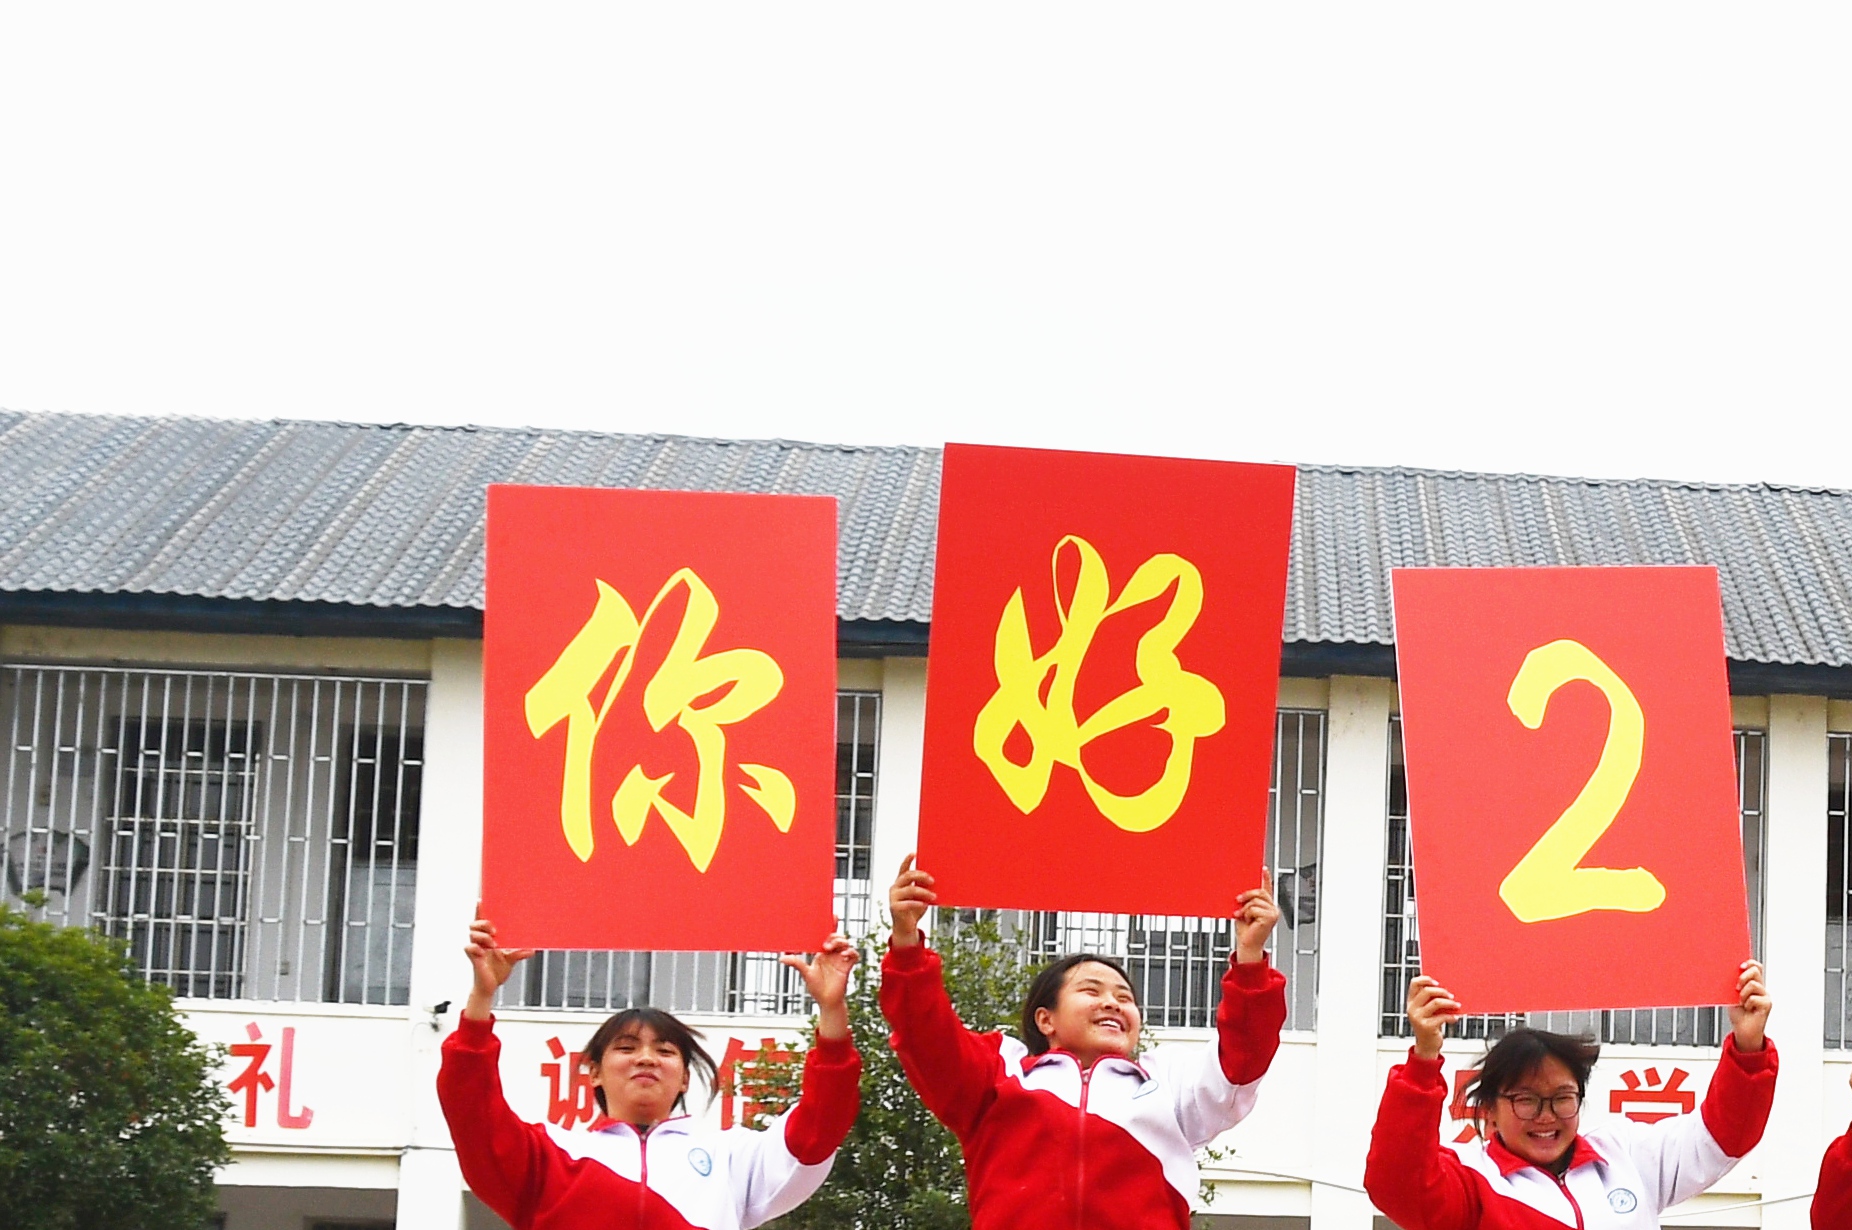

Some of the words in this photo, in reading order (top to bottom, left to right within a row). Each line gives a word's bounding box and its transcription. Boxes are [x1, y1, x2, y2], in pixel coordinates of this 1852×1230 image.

[525, 568, 795, 872] 你
[974, 536, 1225, 832] 好
[1499, 640, 1665, 922] 2
[227, 1021, 314, 1128] 礼
